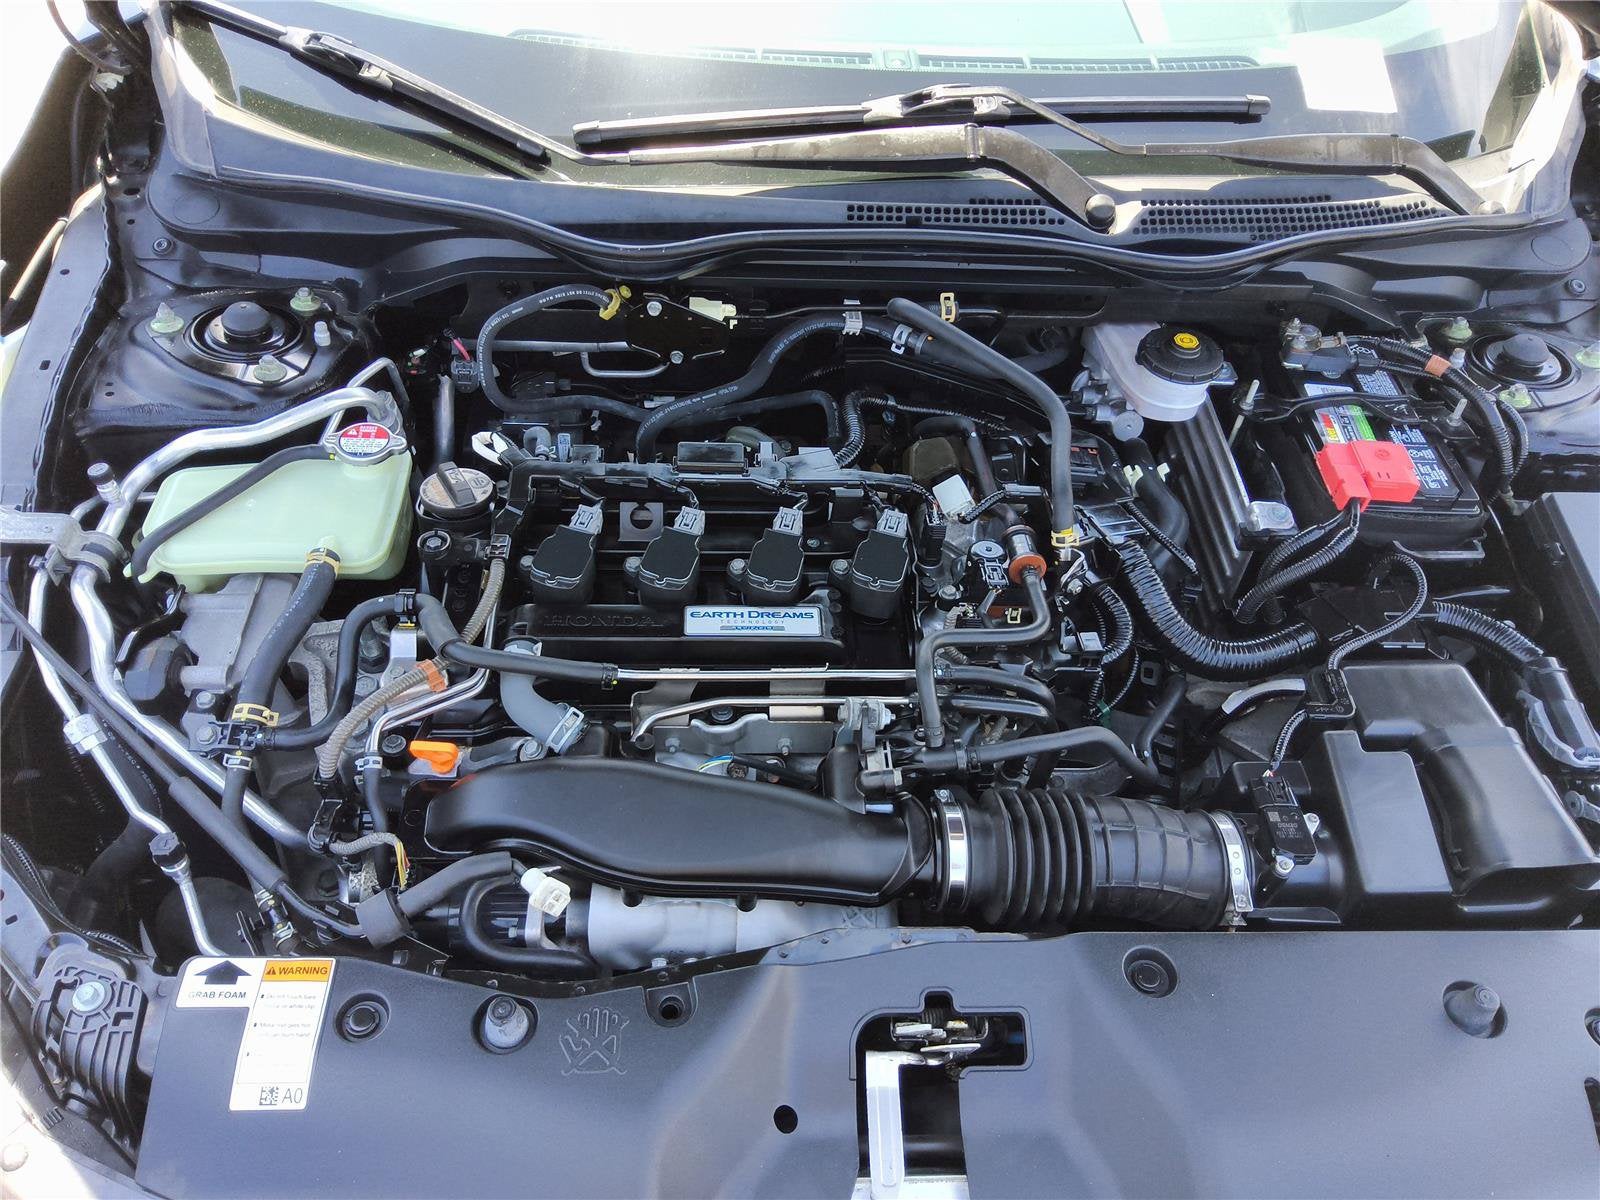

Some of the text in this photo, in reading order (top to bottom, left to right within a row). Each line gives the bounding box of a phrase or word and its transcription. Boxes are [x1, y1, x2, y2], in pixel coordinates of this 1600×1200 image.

[690, 610, 814, 619] EARTH DREAMS
[544, 615, 664, 627] HONDA
[278, 966, 328, 976] WARNING
[188, 991, 247, 999] GRAB FOAM
[281, 1087, 303, 1104] A0
